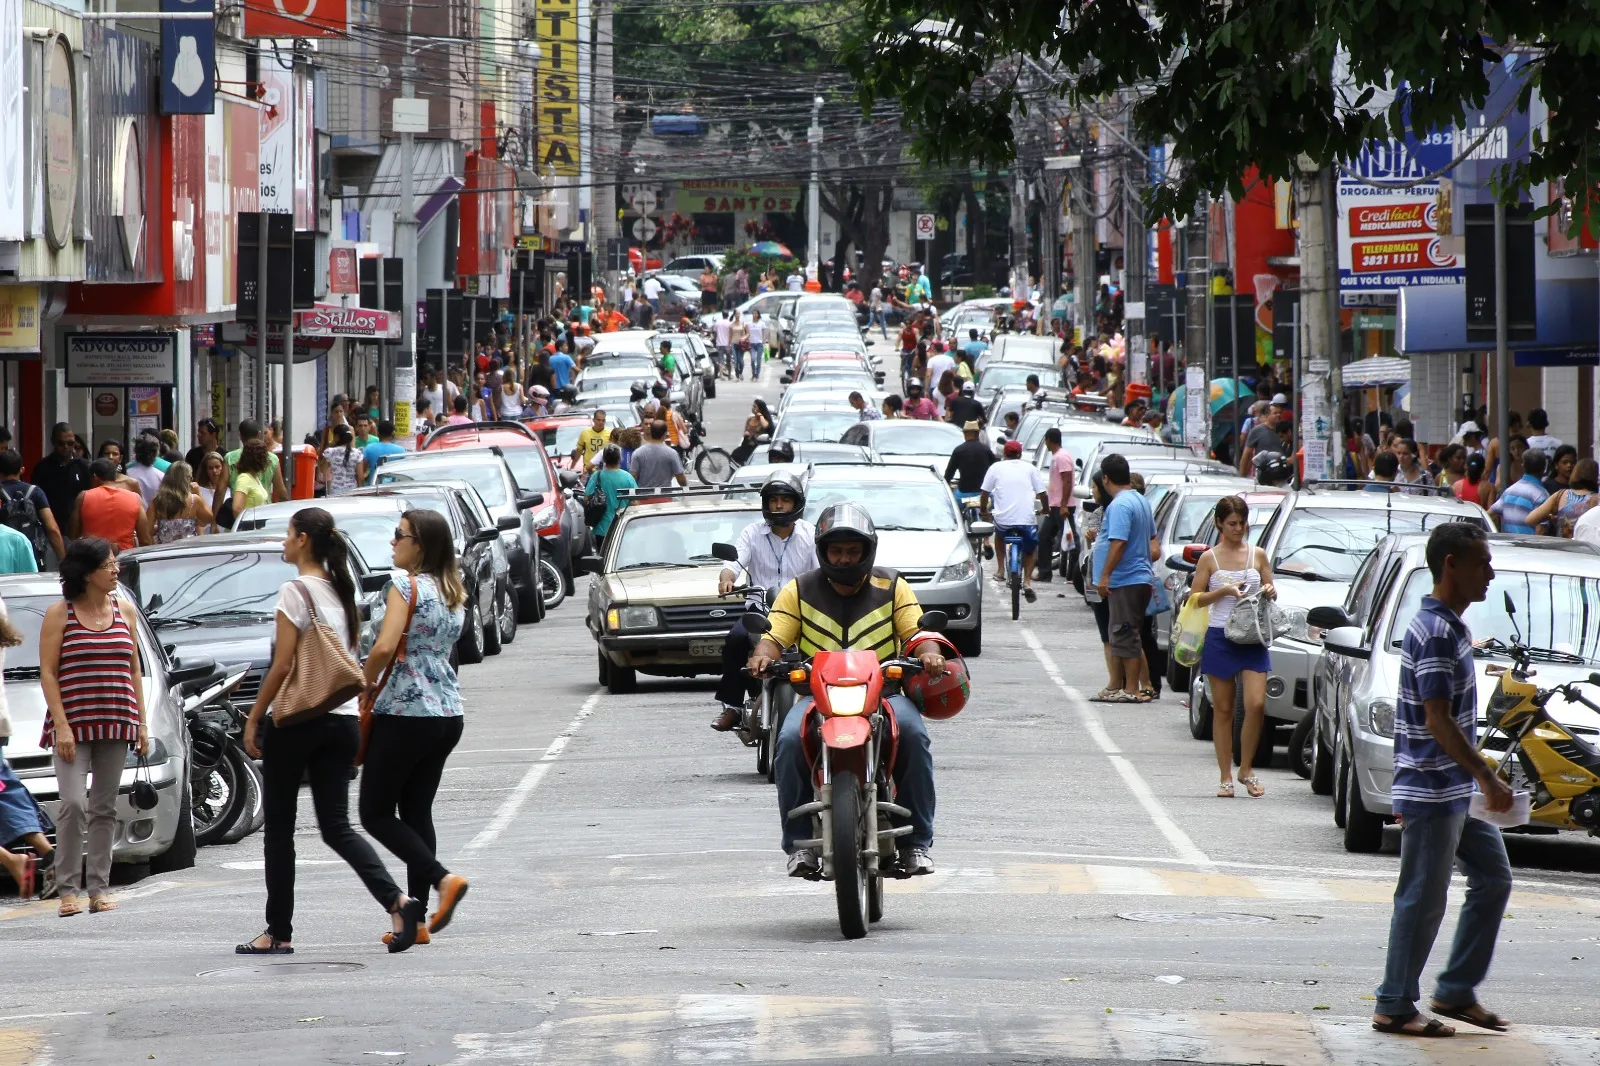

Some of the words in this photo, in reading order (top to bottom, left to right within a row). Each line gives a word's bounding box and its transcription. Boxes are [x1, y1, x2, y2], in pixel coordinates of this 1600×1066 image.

[541, 0, 574, 166] TISTA
[1340, 188, 1393, 196] DROGARIA
[704, 197, 791, 211] SANTOS
[1360, 209, 1390, 222] Credi
[1391, 206, 1419, 221] fácil
[1360, 220, 1422, 230] MEDICAMENTOS
[1362, 242, 1418, 254] TELEFARMÁCIA
[1362, 255, 1388, 266] 3821
[1393, 254, 1418, 263] 1111
[1340, 277, 1357, 285] QUE
[1360, 275, 1381, 285] VOCÊ
[1384, 276, 1409, 286] QUER,
[1412, 276, 1418, 284] A
[1421, 275, 1456, 285] INDIANA
[314, 311, 376, 328] Stillos
[692, 645, 715, 655] GTS
